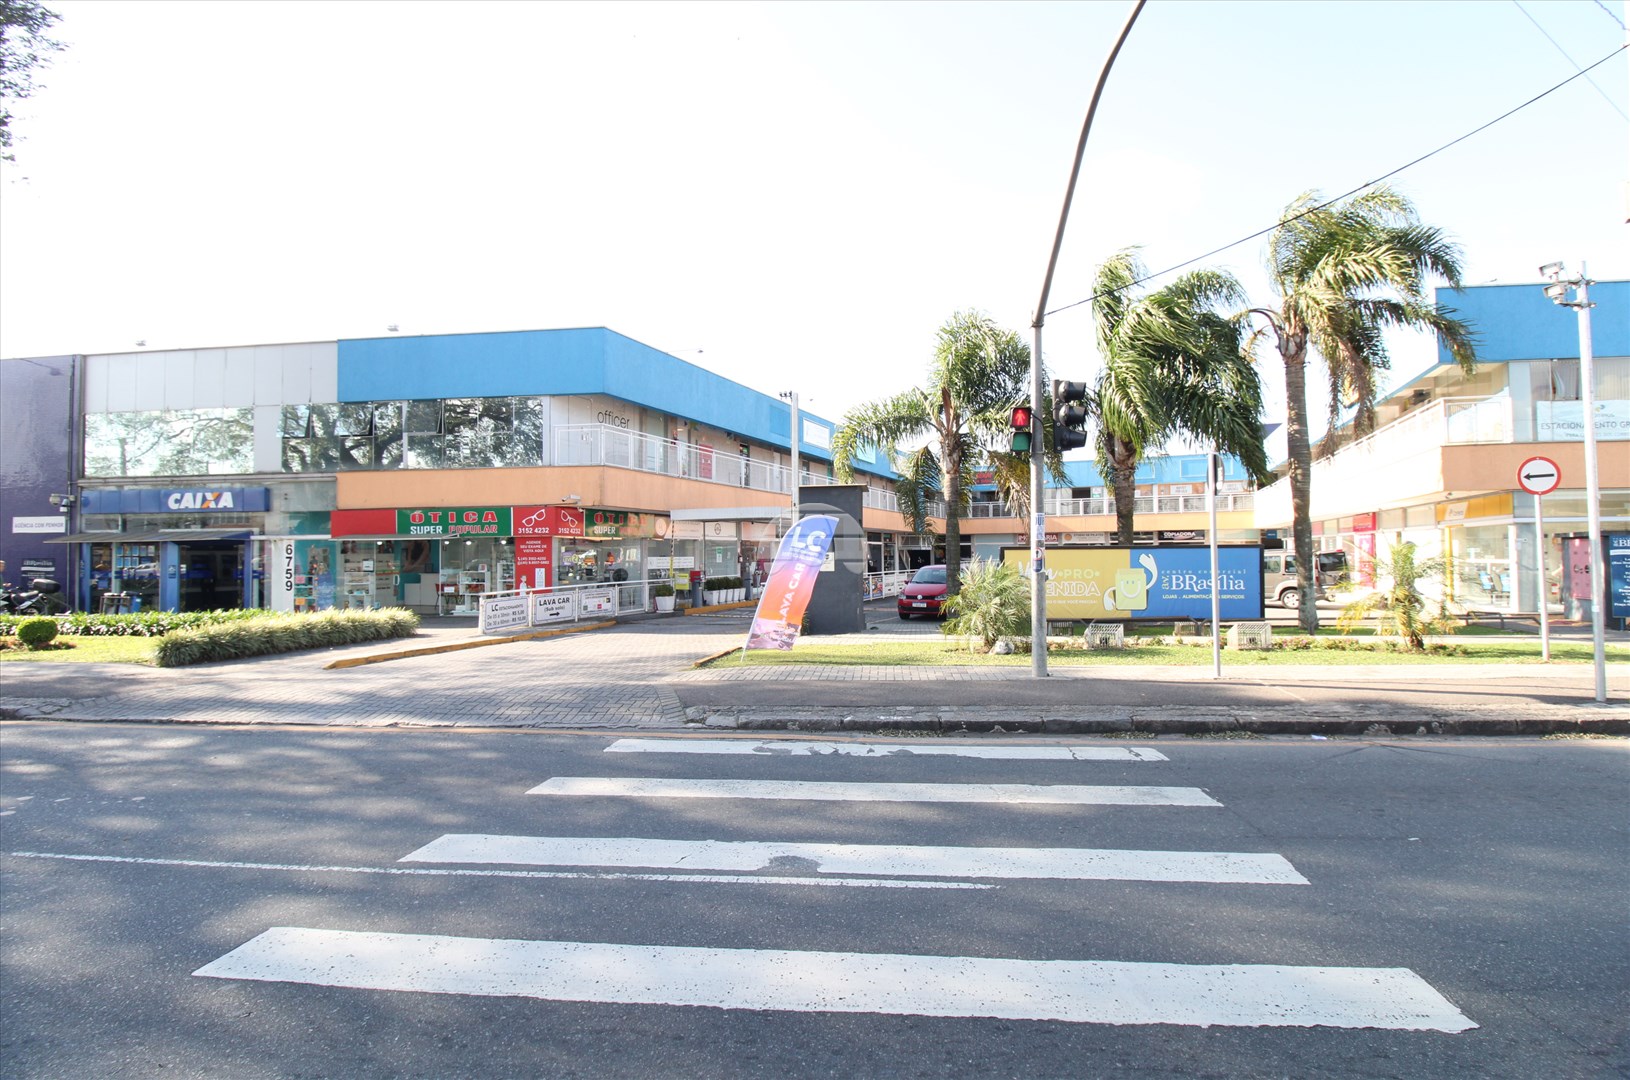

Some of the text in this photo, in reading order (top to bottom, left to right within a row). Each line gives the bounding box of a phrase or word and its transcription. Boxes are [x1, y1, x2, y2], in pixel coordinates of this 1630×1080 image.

[597, 410, 630, 429] officer
[1541, 421, 1617, 430] ESTACIONAENTO
[168, 492, 234, 509] CAIXA
[410, 524, 498, 535] SUPER POPULAR
[594, 526, 616, 535] SUPER
[791, 526, 826, 551] LC
[779, 592, 795, 624] LAVA
[789, 563, 806, 589] CAR
[539, 598, 556, 606] LAVA
[491, 604, 499, 612] LC
